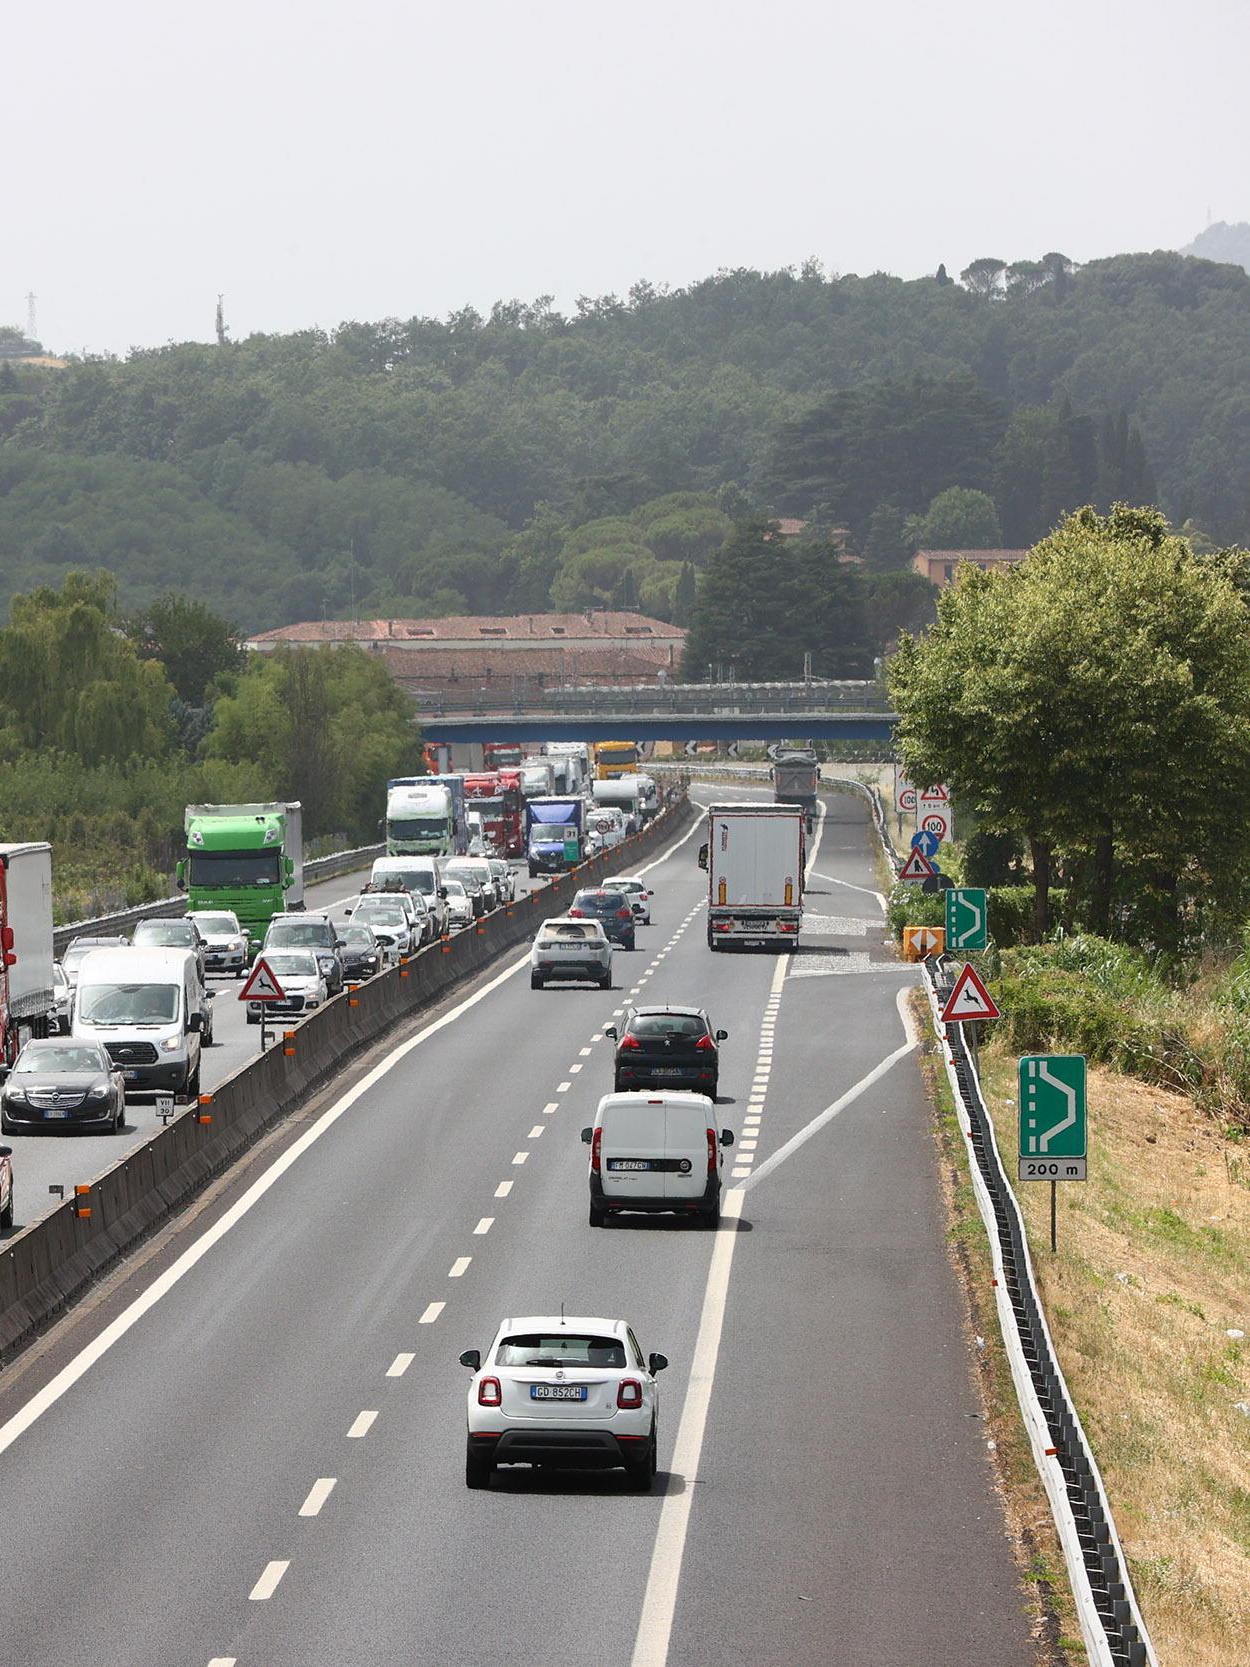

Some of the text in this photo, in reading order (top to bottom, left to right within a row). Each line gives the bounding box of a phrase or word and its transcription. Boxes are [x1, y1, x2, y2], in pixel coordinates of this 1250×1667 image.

[927, 822, 942, 832] 100
[566, 830, 576, 838] 31
[1027, 1163, 1078, 1176] 200 m
